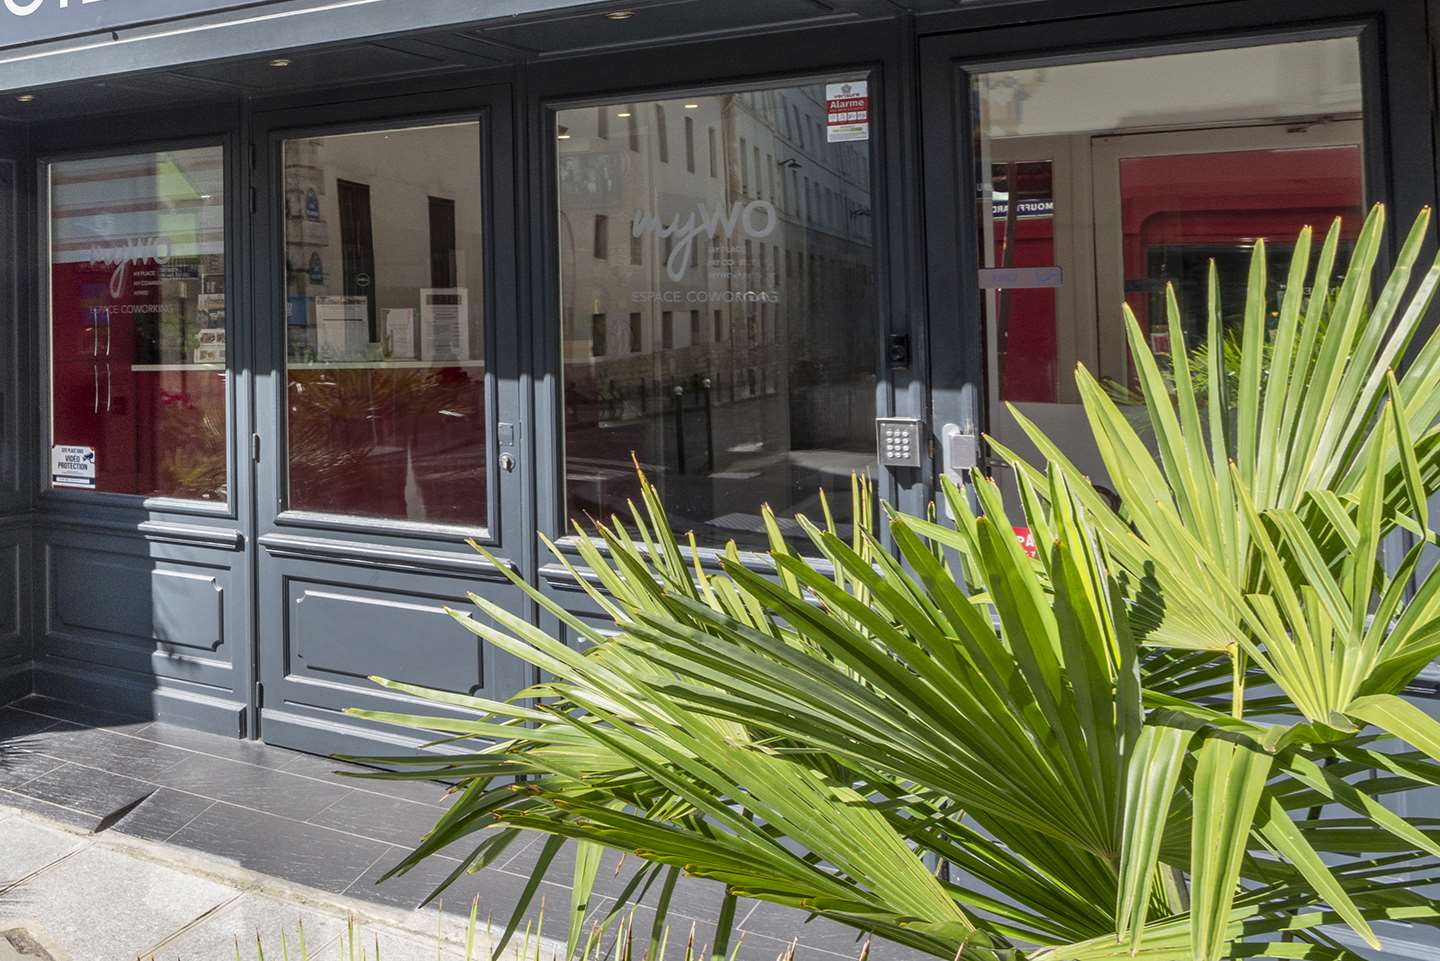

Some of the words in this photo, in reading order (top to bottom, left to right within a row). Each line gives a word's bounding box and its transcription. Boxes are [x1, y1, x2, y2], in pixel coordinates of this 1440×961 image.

[831, 100, 864, 108] Alarme
[631, 291, 681, 303] ESPACE
[58, 462, 88, 470] PROTECTION
